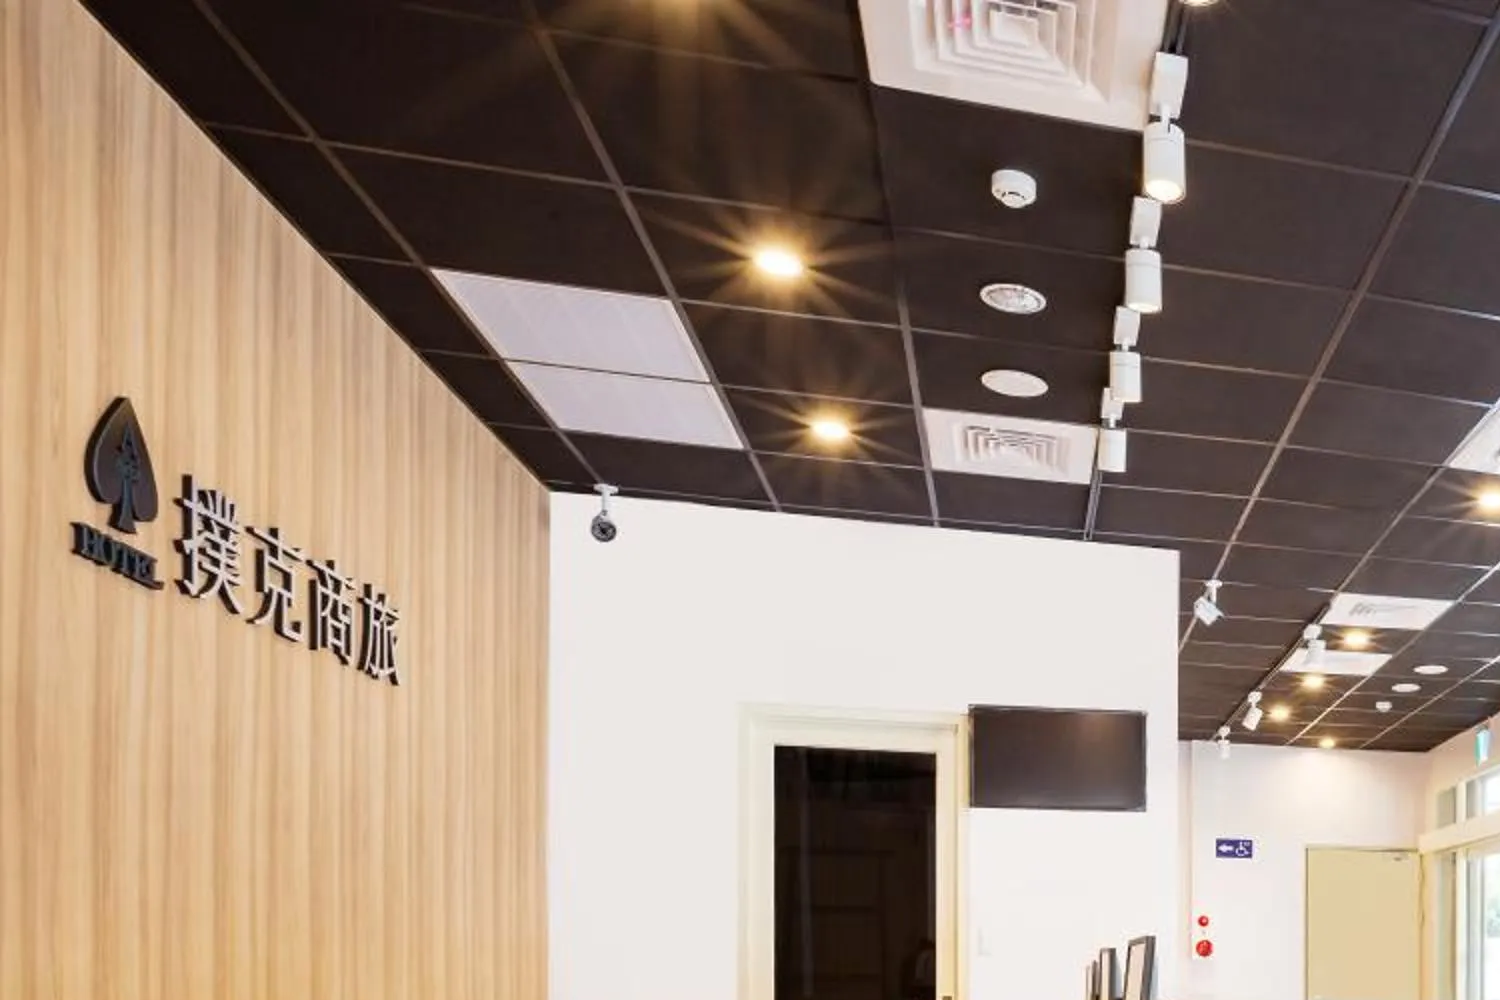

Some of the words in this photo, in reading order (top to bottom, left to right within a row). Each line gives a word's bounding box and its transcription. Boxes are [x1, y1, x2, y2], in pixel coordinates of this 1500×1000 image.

[70, 521, 164, 590] HOTEL
[173, 474, 400, 686] 撲克商旅
